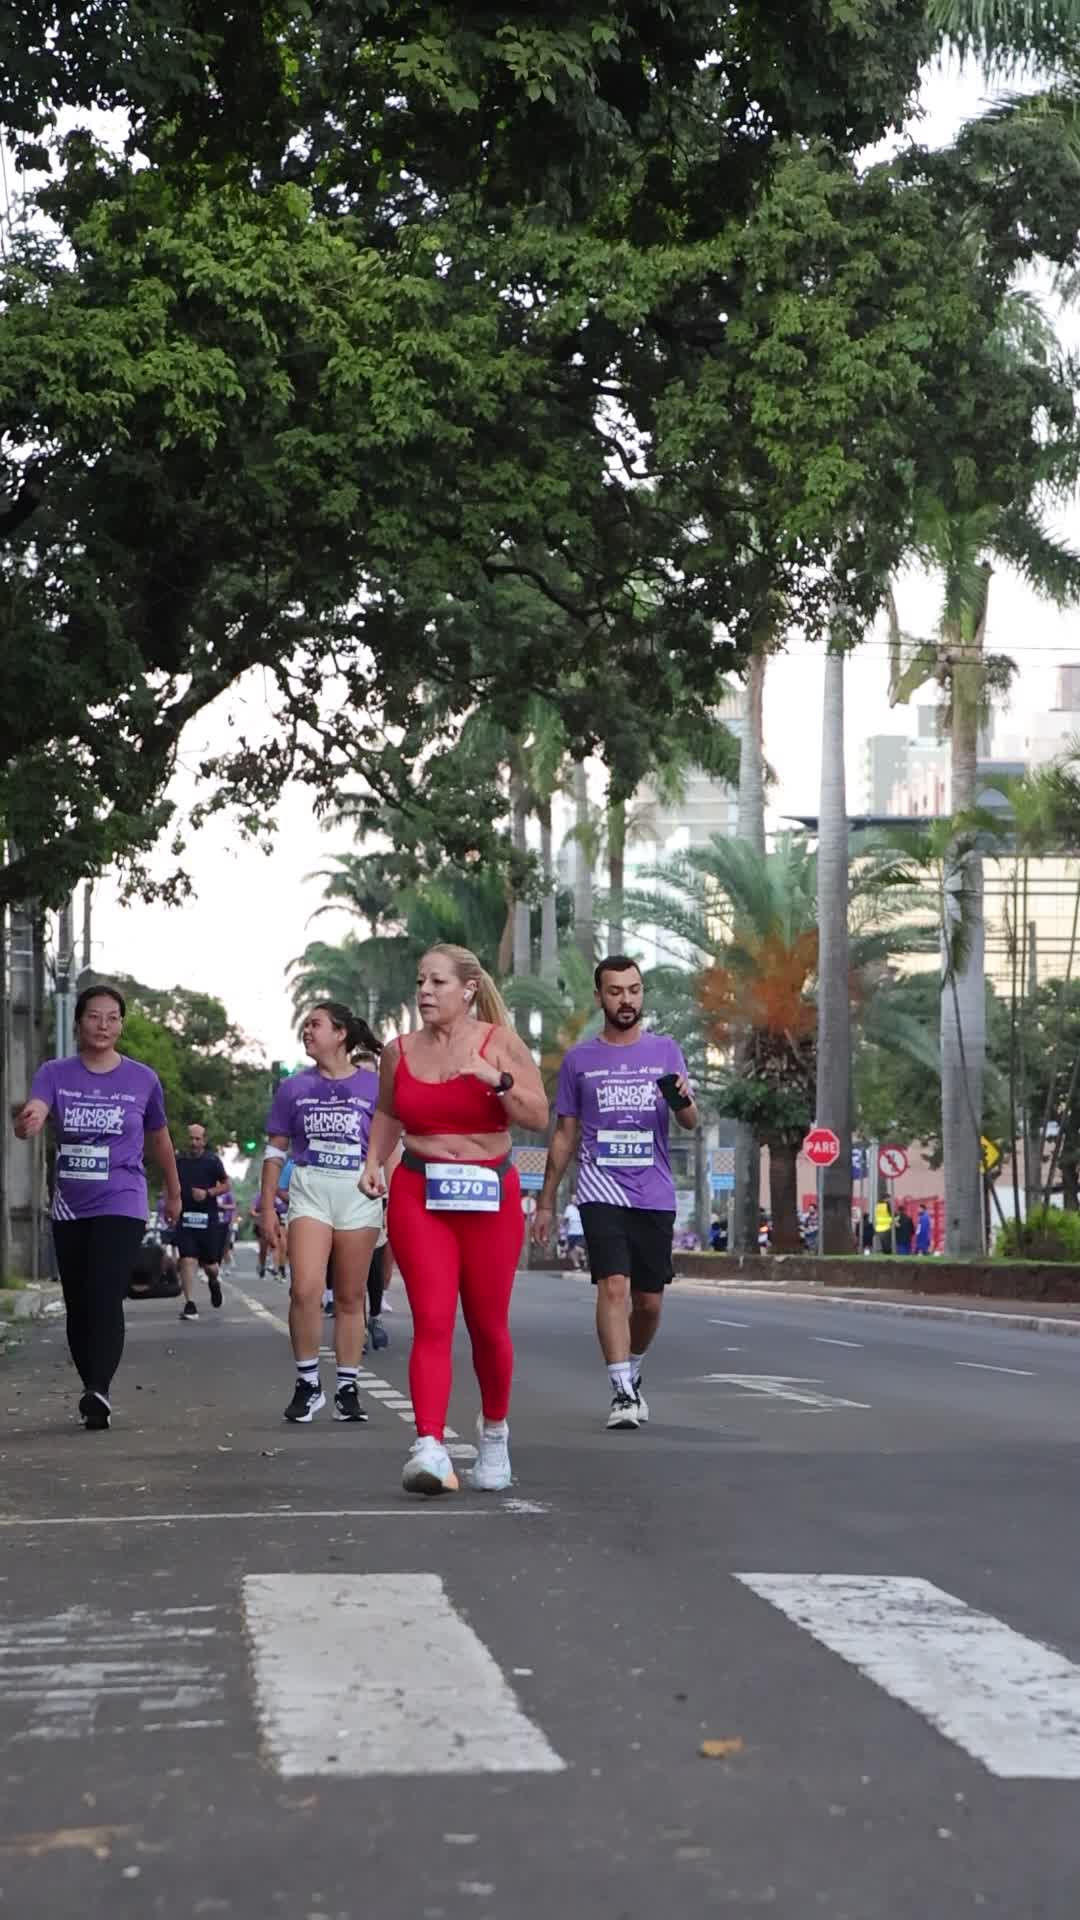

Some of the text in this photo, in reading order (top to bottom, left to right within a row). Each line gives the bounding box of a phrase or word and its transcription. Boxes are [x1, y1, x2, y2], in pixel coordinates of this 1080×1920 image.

[609, 1143, 642, 1154] 5316
[806, 1141, 837, 1154] PARE
[68, 1157, 97, 1168] 5280
[318, 1153, 349, 1166] 5026
[439, 1180, 484, 1194] 6370
